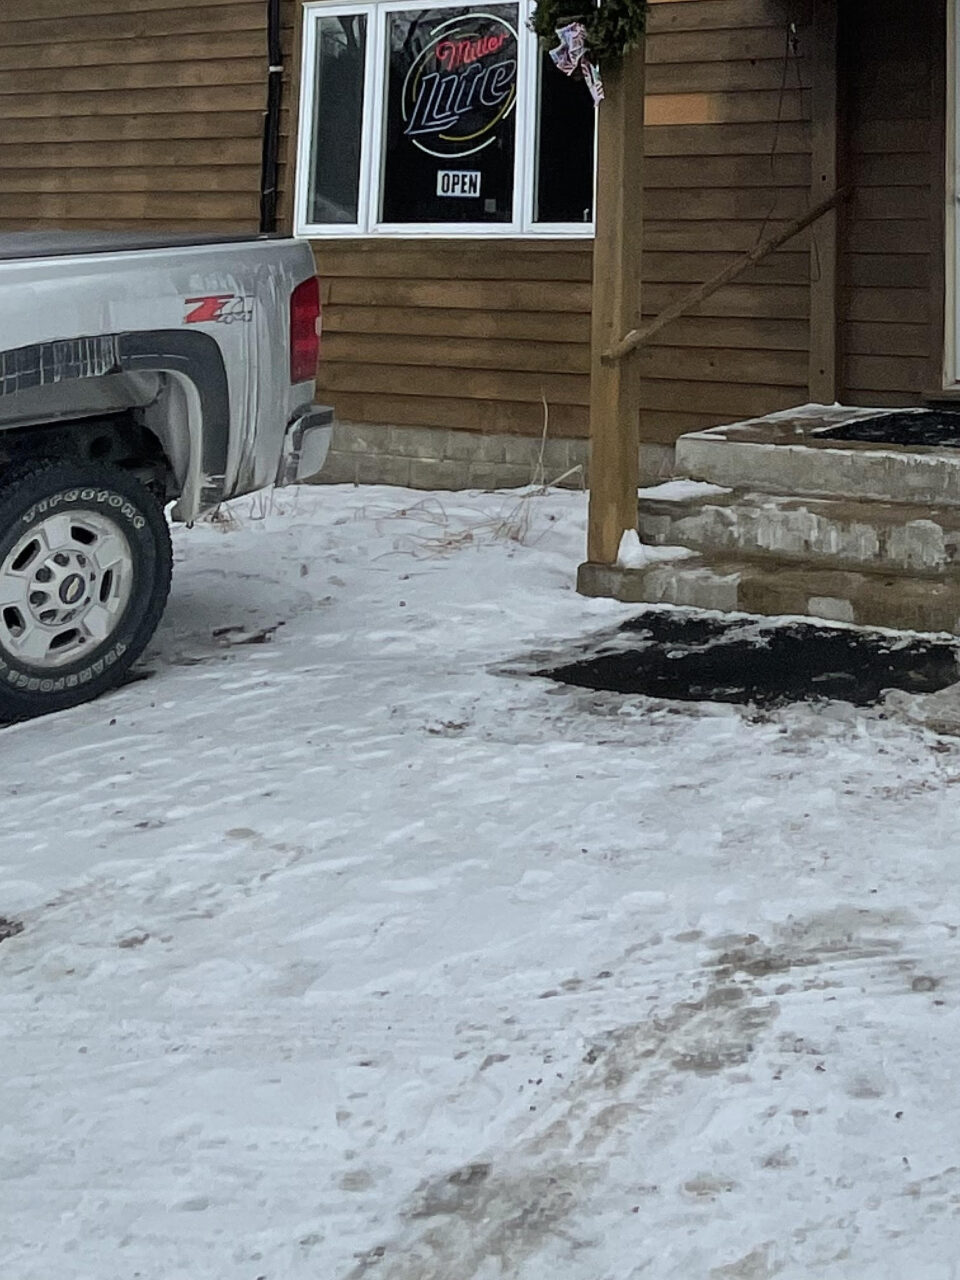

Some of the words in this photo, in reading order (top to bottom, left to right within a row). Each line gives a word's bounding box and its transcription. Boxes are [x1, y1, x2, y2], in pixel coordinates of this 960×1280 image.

[436, 32, 510, 70] Miller
[404, 59, 516, 135] Lite
[441, 173, 478, 194] OPEN
